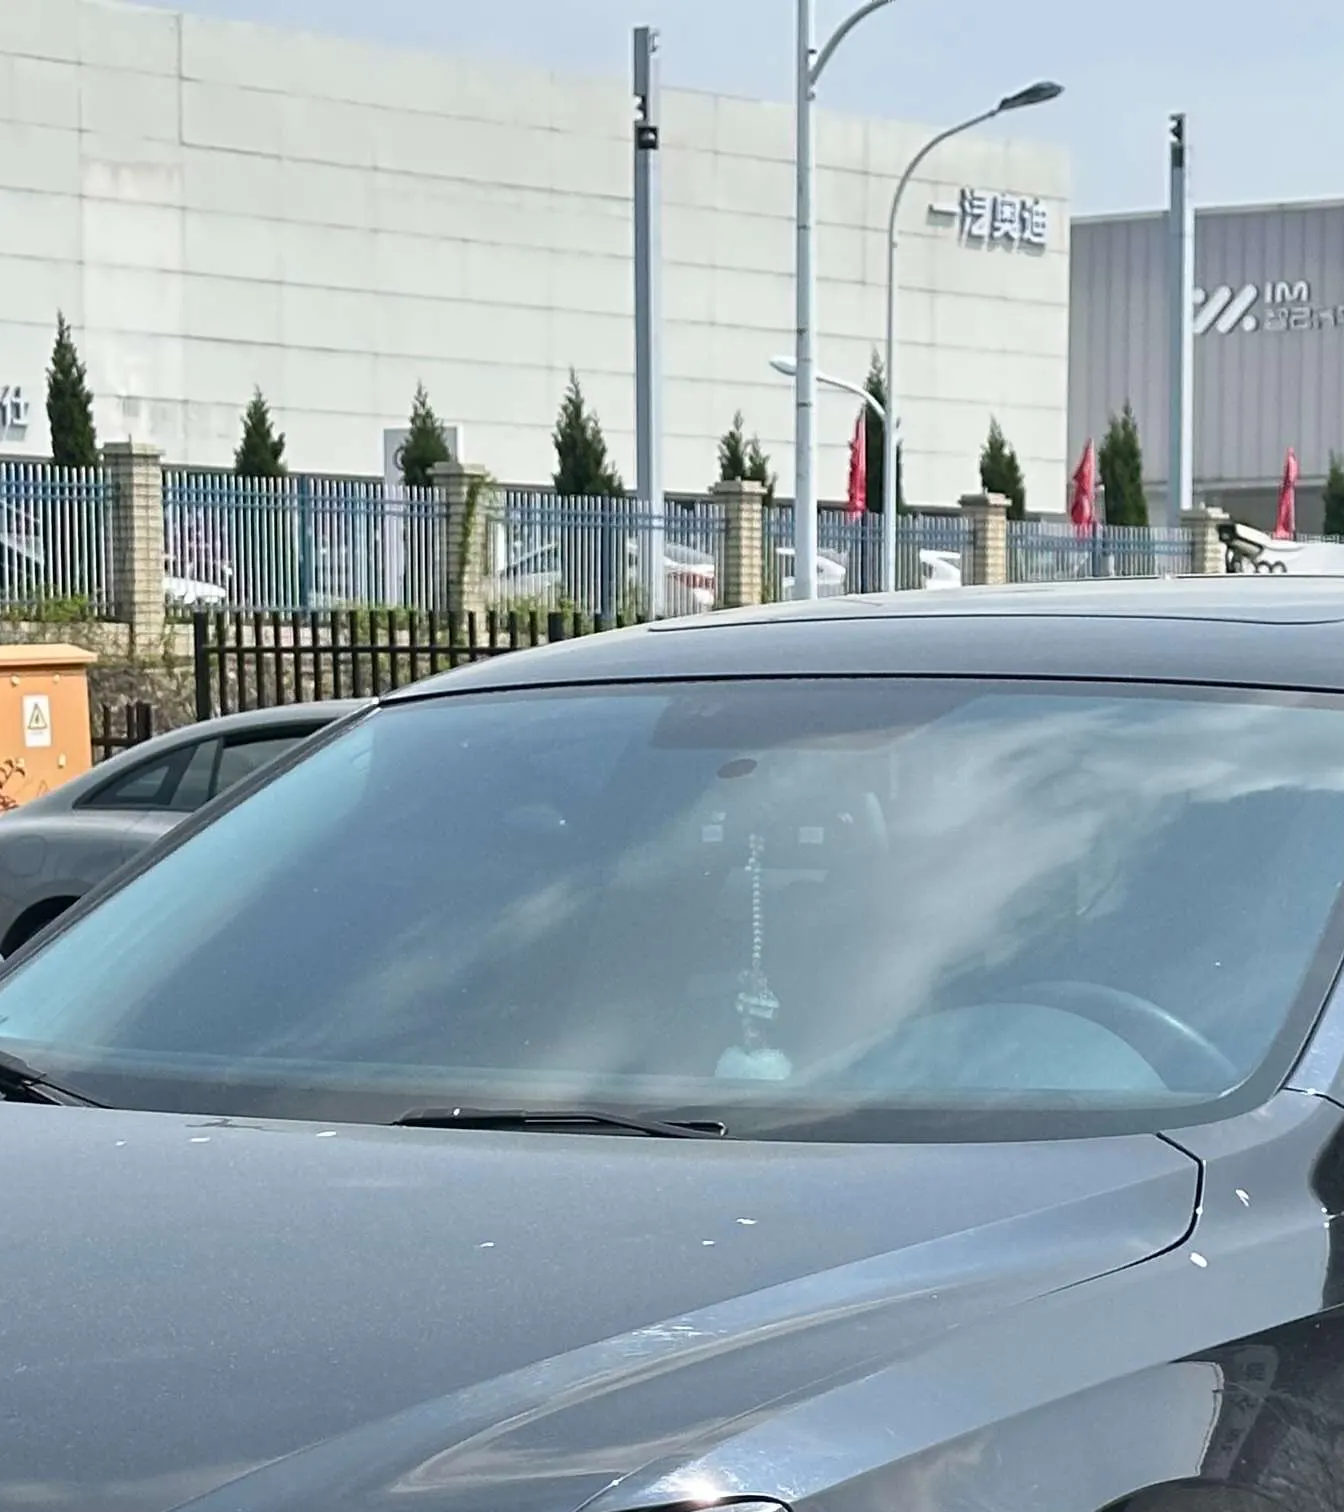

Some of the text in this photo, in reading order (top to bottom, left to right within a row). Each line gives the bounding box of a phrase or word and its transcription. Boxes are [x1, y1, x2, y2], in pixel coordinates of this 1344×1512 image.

[928, 186, 1048, 245] 一汽奥迪
[1264, 280, 1310, 304] IM
